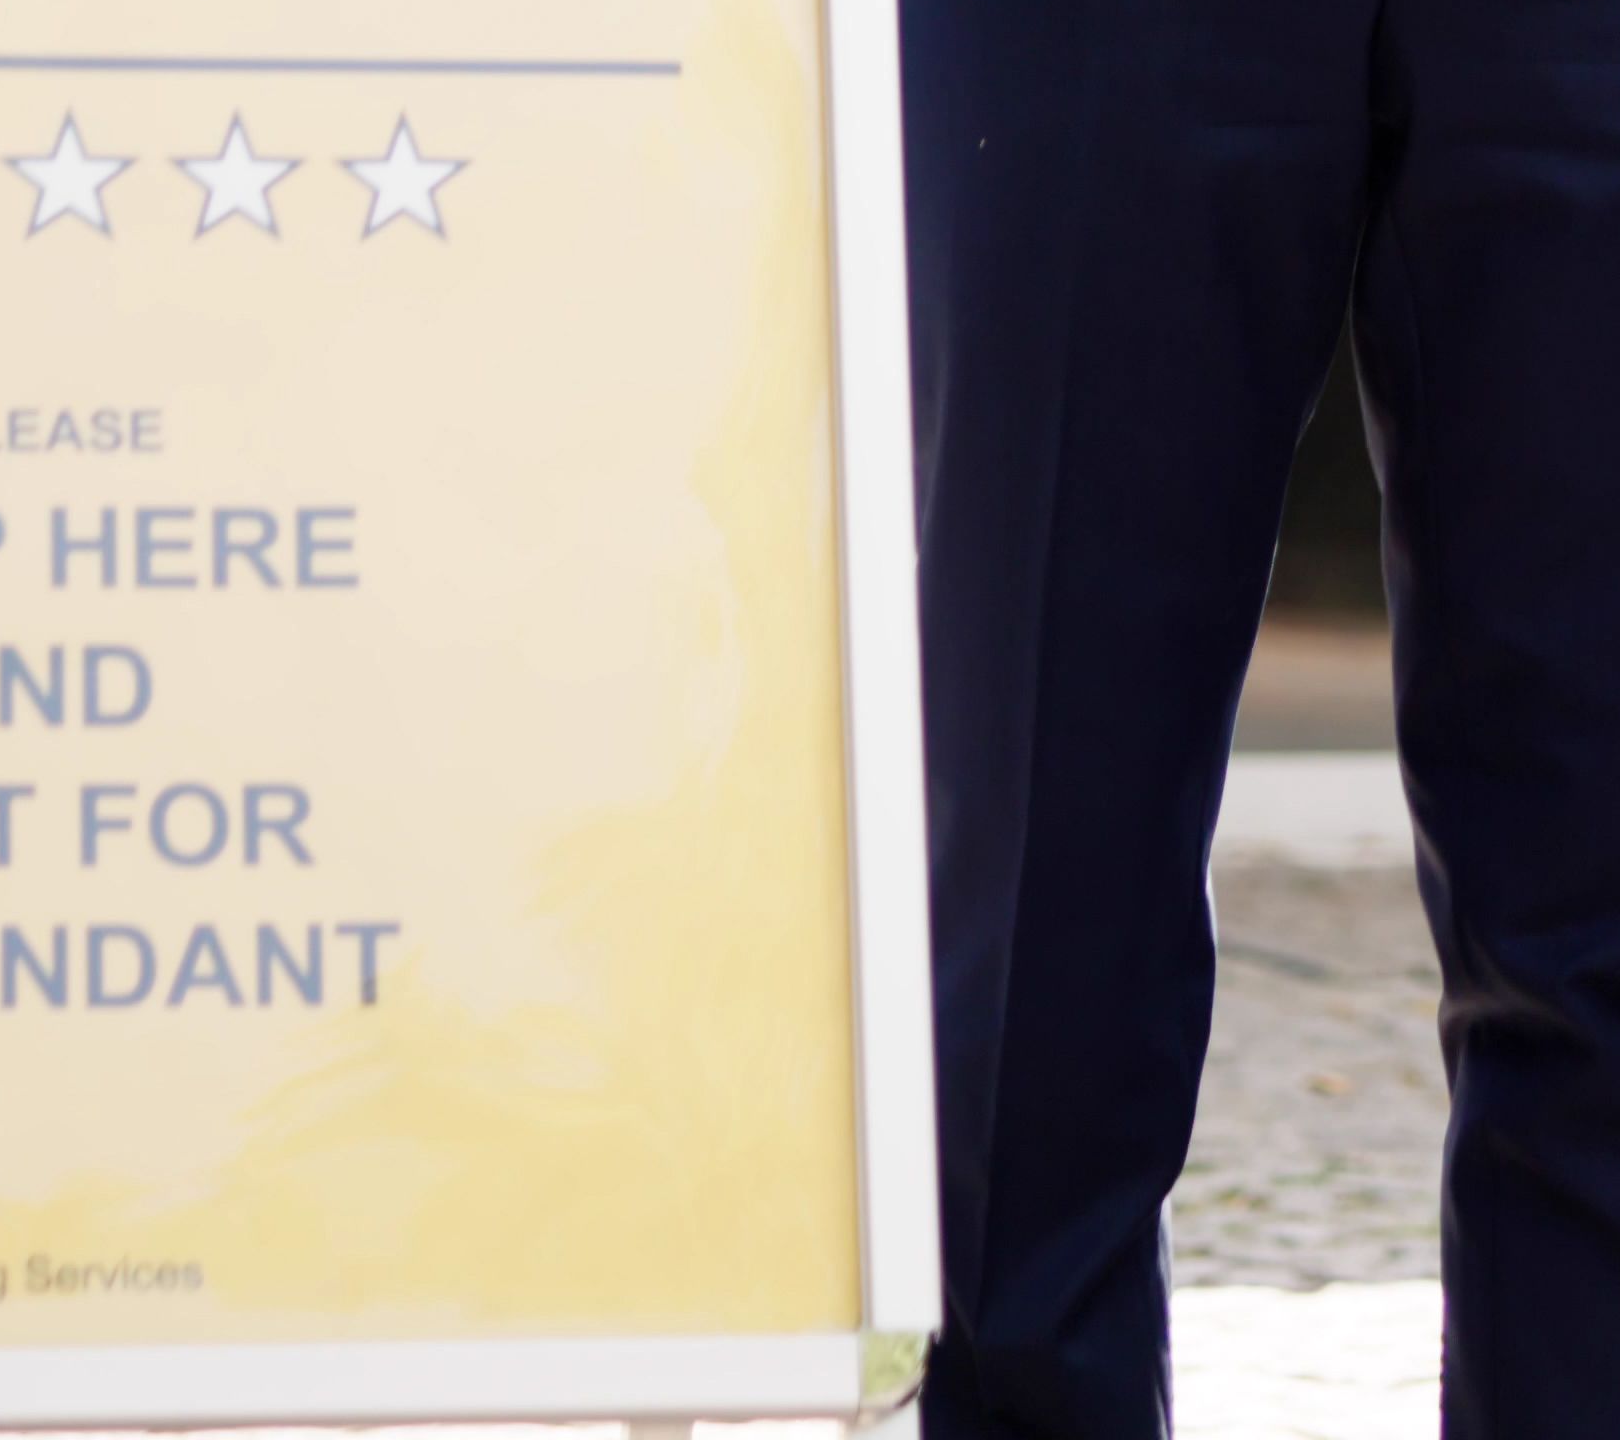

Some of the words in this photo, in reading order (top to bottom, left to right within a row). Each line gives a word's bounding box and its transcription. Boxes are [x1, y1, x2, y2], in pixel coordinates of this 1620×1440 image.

[51, 507, 360, 589] HERE
[79, 783, 314, 868] FOR
[25, 1253, 205, 1294] Services
